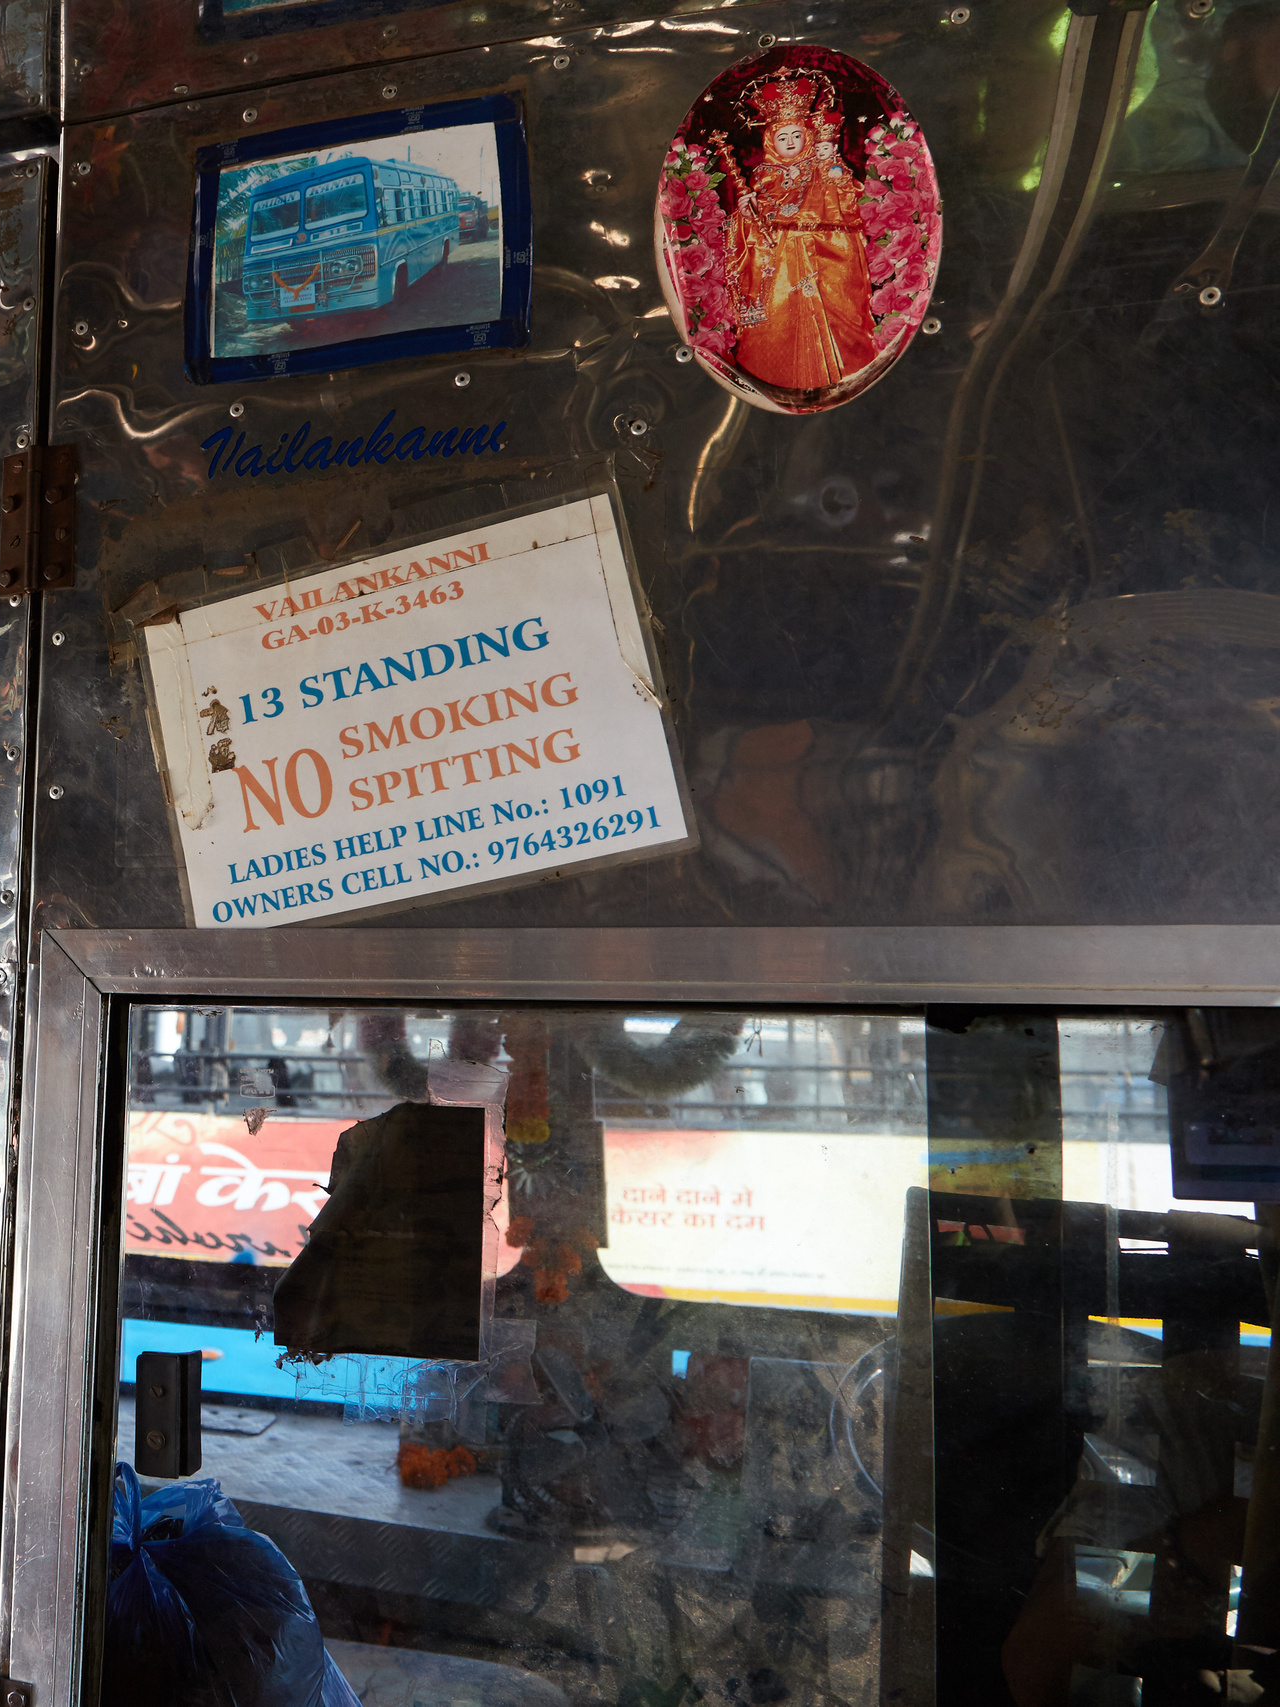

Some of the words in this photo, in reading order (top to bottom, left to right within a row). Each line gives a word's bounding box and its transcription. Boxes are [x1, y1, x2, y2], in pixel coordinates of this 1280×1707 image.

[253, 541, 491, 621] VAILANKANNI
[261, 580, 464, 650] GA-03-K-3463
[238, 686, 284, 725] 13
[299, 616, 550, 709] STANDING
[339, 672, 579, 760] SMOKING
[231, 748, 334, 834] NO
[348, 728, 581, 812] SPITTING
[212, 878, 334, 924] OWNERS
[341, 862, 412, 896] CELL
[487, 805, 663, 866] 9764326291
[228, 842, 327, 885] LADIES
[334, 824, 407, 862] HELP
[417, 807, 485, 843] LINE
[559, 774, 628, 811] 1091
